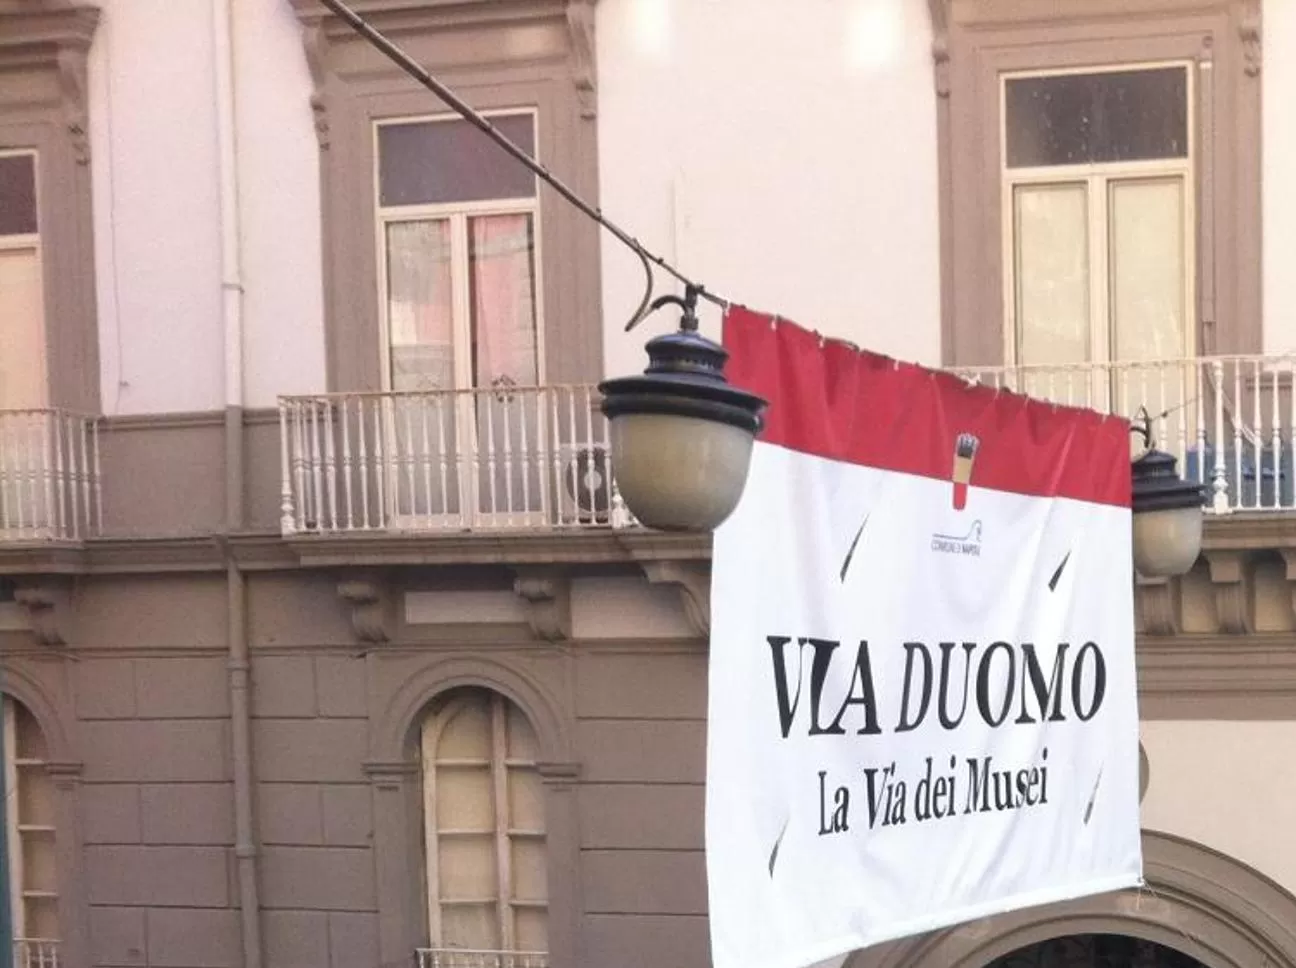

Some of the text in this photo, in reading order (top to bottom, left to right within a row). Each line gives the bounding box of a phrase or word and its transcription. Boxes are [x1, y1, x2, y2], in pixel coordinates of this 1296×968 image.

[766, 634, 1107, 739] VIA DUOMO
[818, 747, 1048, 836] La Via dei Musei
